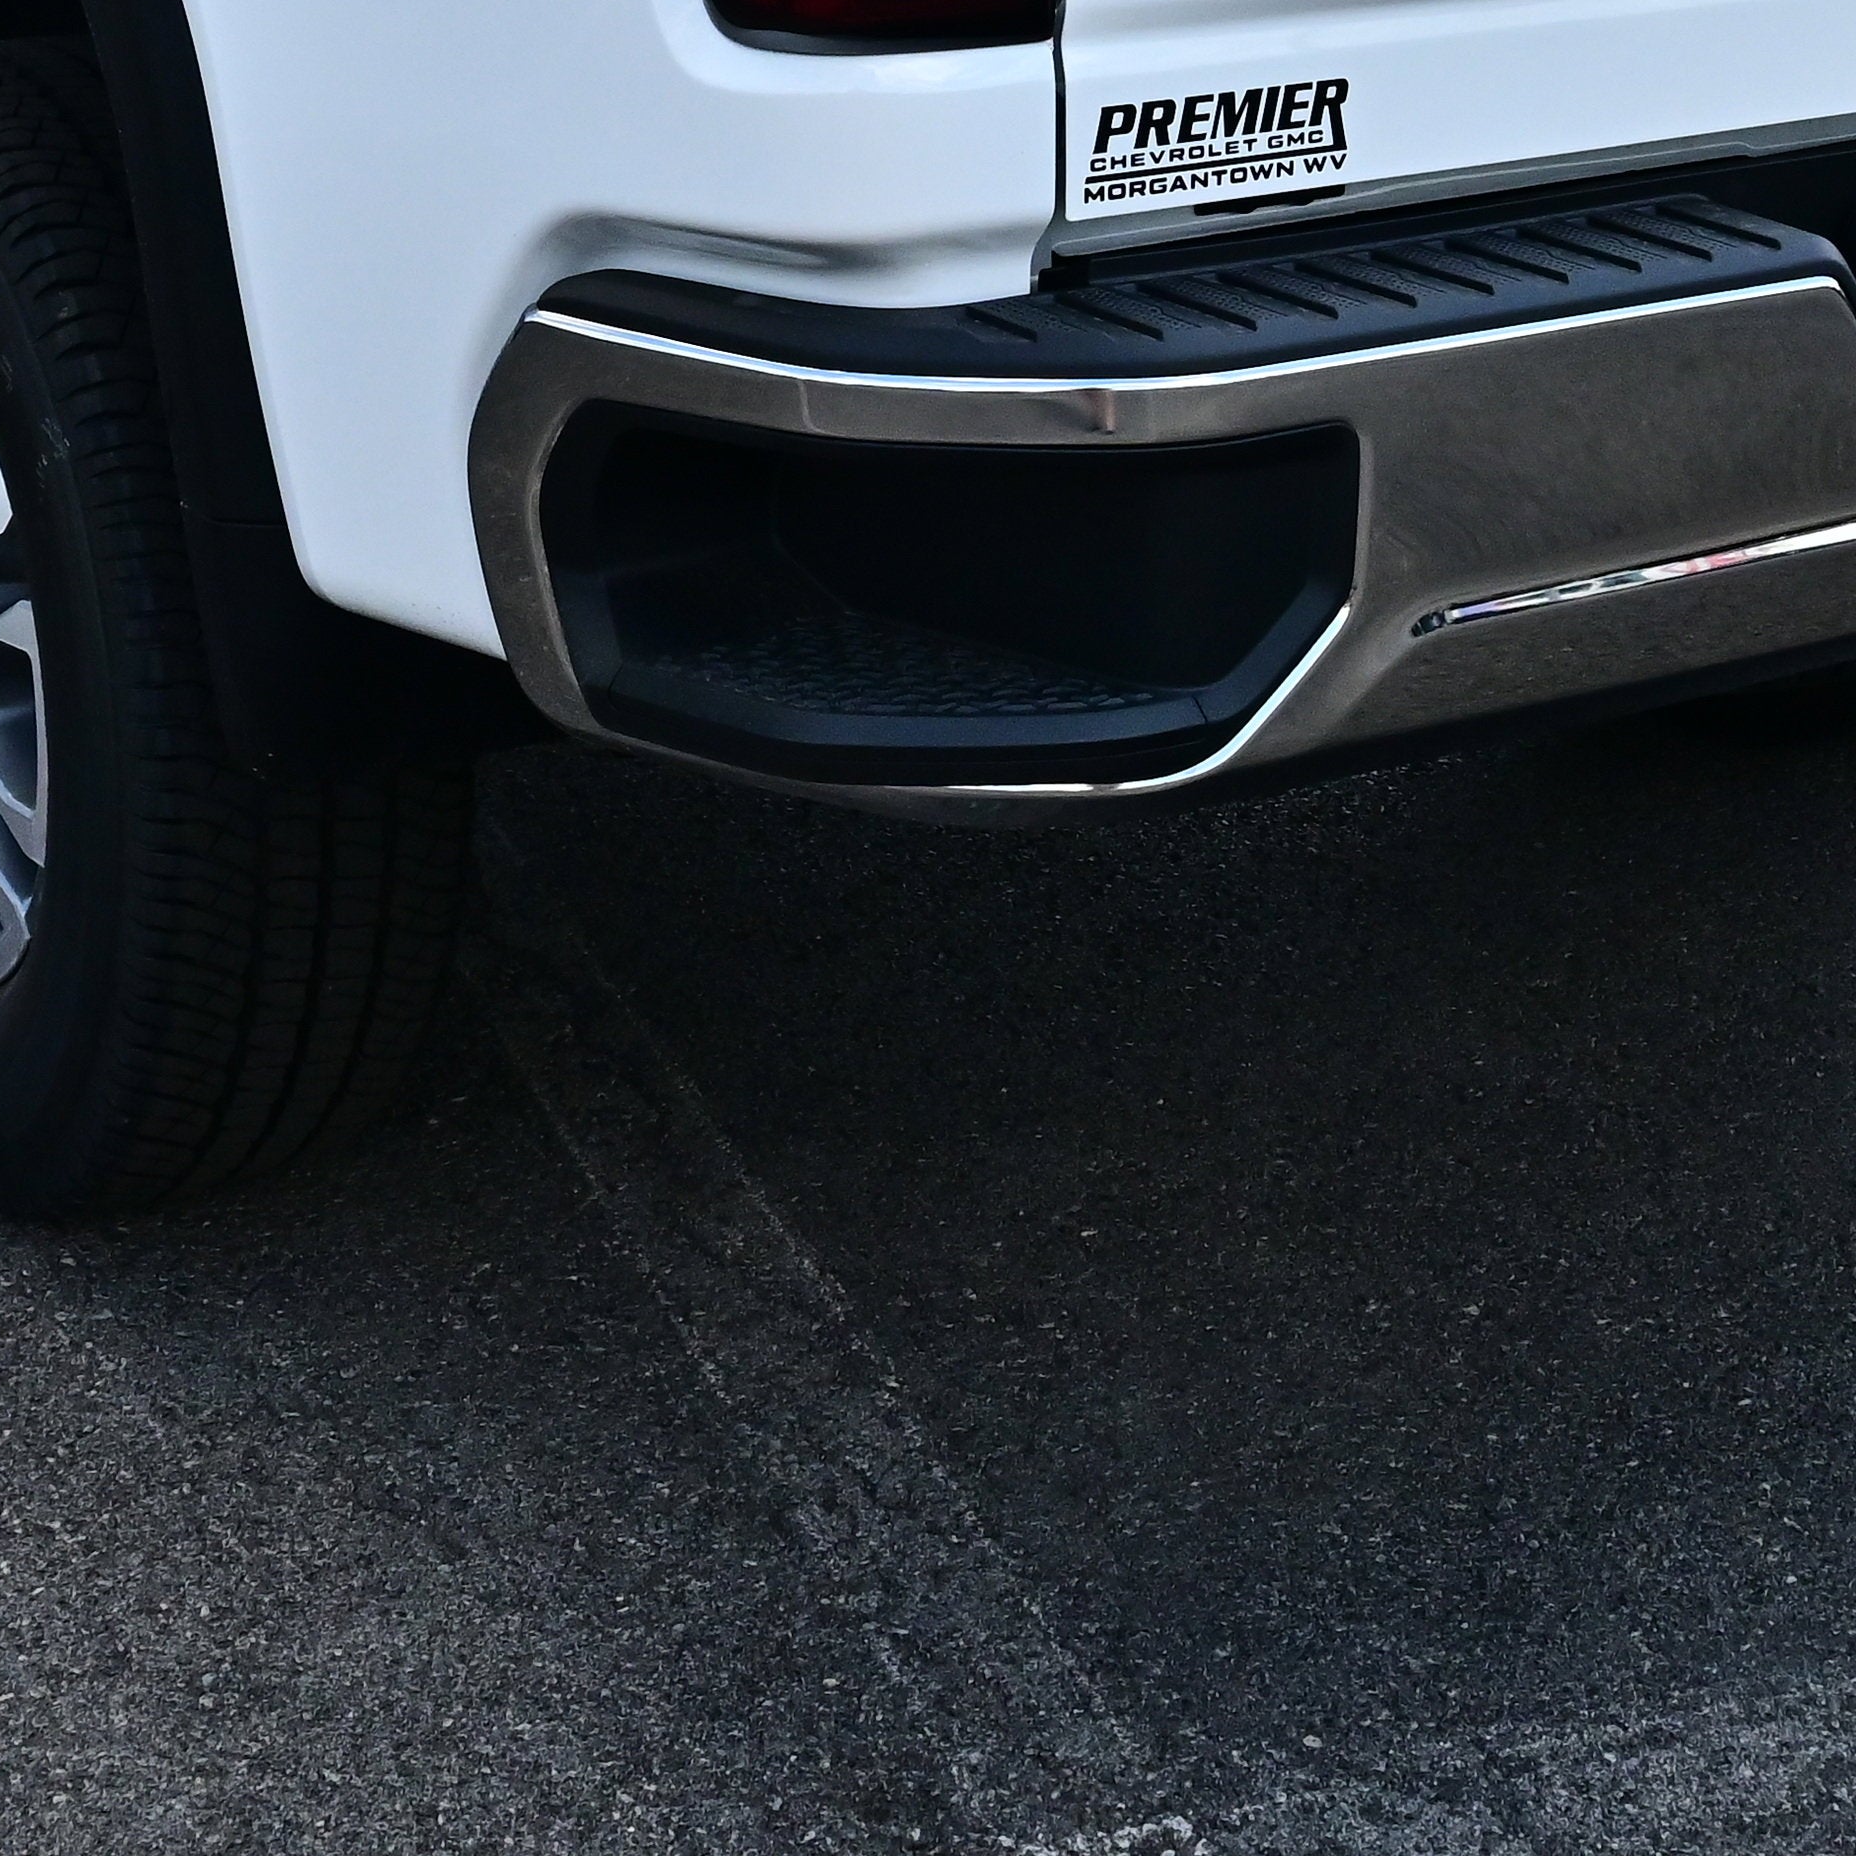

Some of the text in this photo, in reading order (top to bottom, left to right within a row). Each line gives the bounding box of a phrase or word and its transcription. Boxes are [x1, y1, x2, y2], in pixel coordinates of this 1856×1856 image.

[1093, 78, 1348, 155] PREMIER
[1090, 129, 1324, 172] CHEVROLET GMC
[1083, 153, 1347, 204] MORGANTOWN WV
